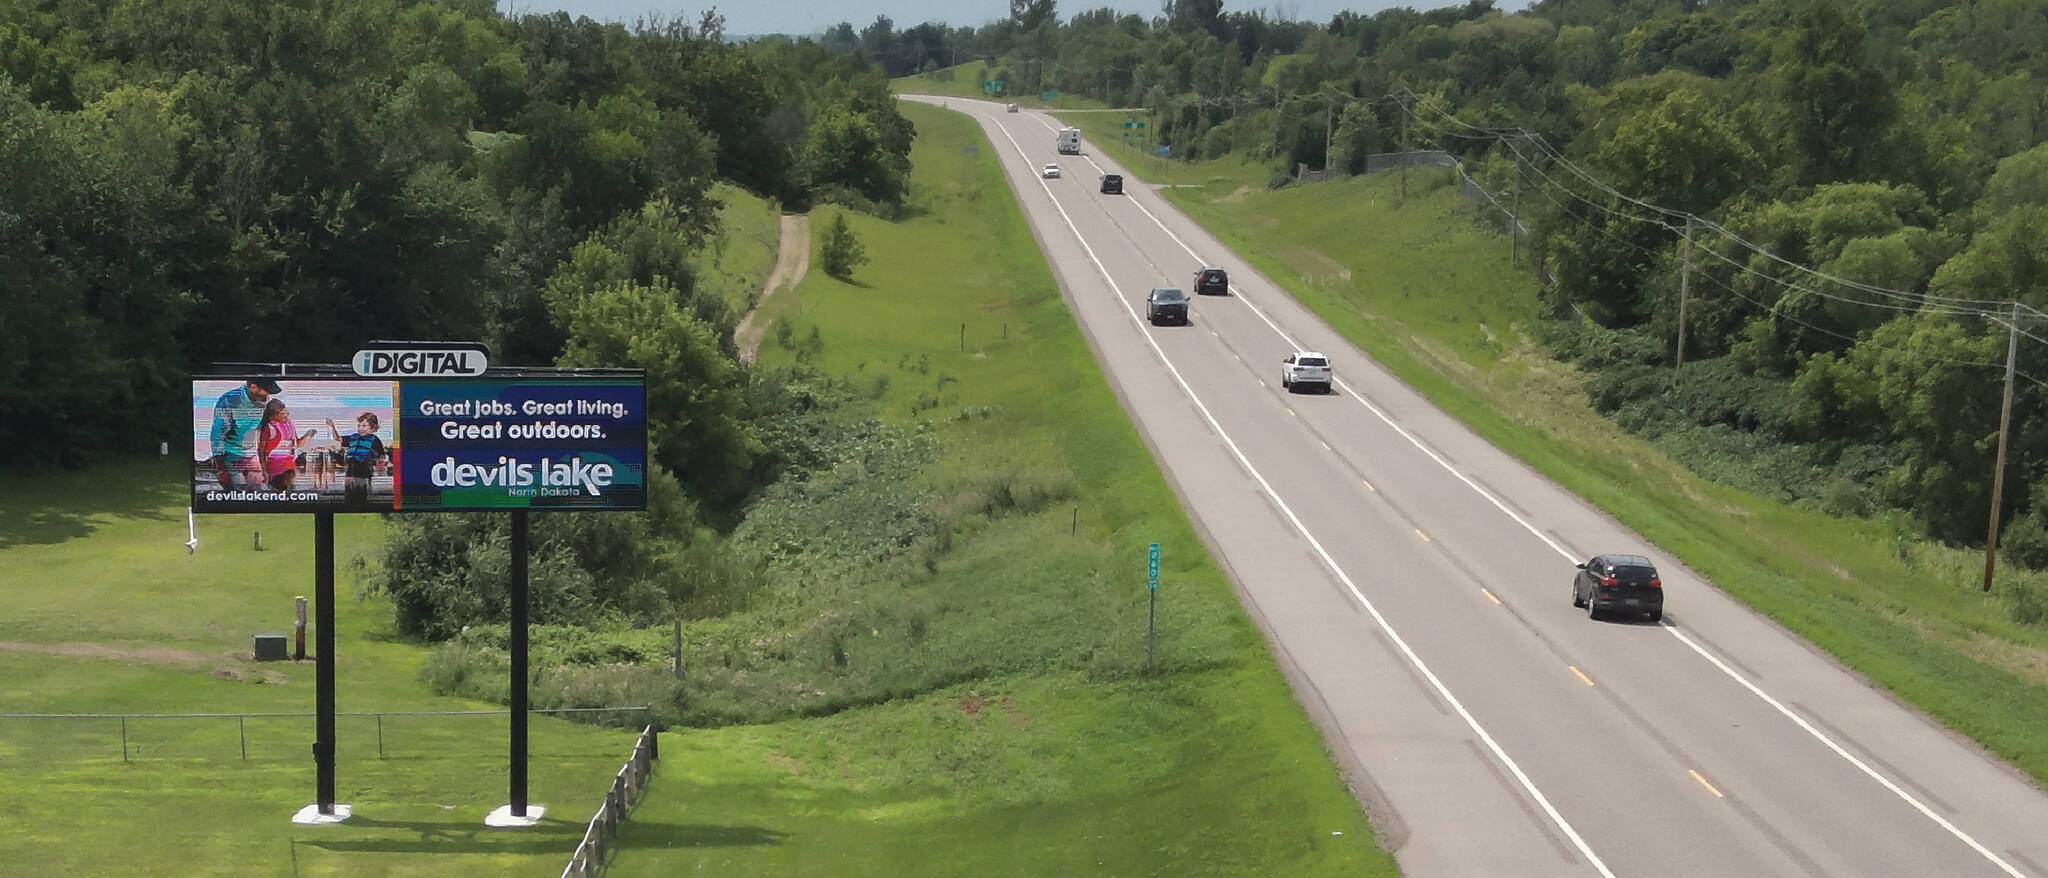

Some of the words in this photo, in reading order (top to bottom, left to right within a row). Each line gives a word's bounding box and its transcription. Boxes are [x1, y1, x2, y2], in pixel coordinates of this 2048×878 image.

[419, 400, 471, 416] Great
[473, 400, 517, 419] jobs.
[522, 400, 573, 416] Great
[577, 399, 628, 419] living.
[440, 420, 502, 439] Great
[508, 420, 606, 439] outdoors.
[431, 456, 534, 487] devils
[541, 456, 613, 496] lake
[541, 487, 580, 497] Dakota
